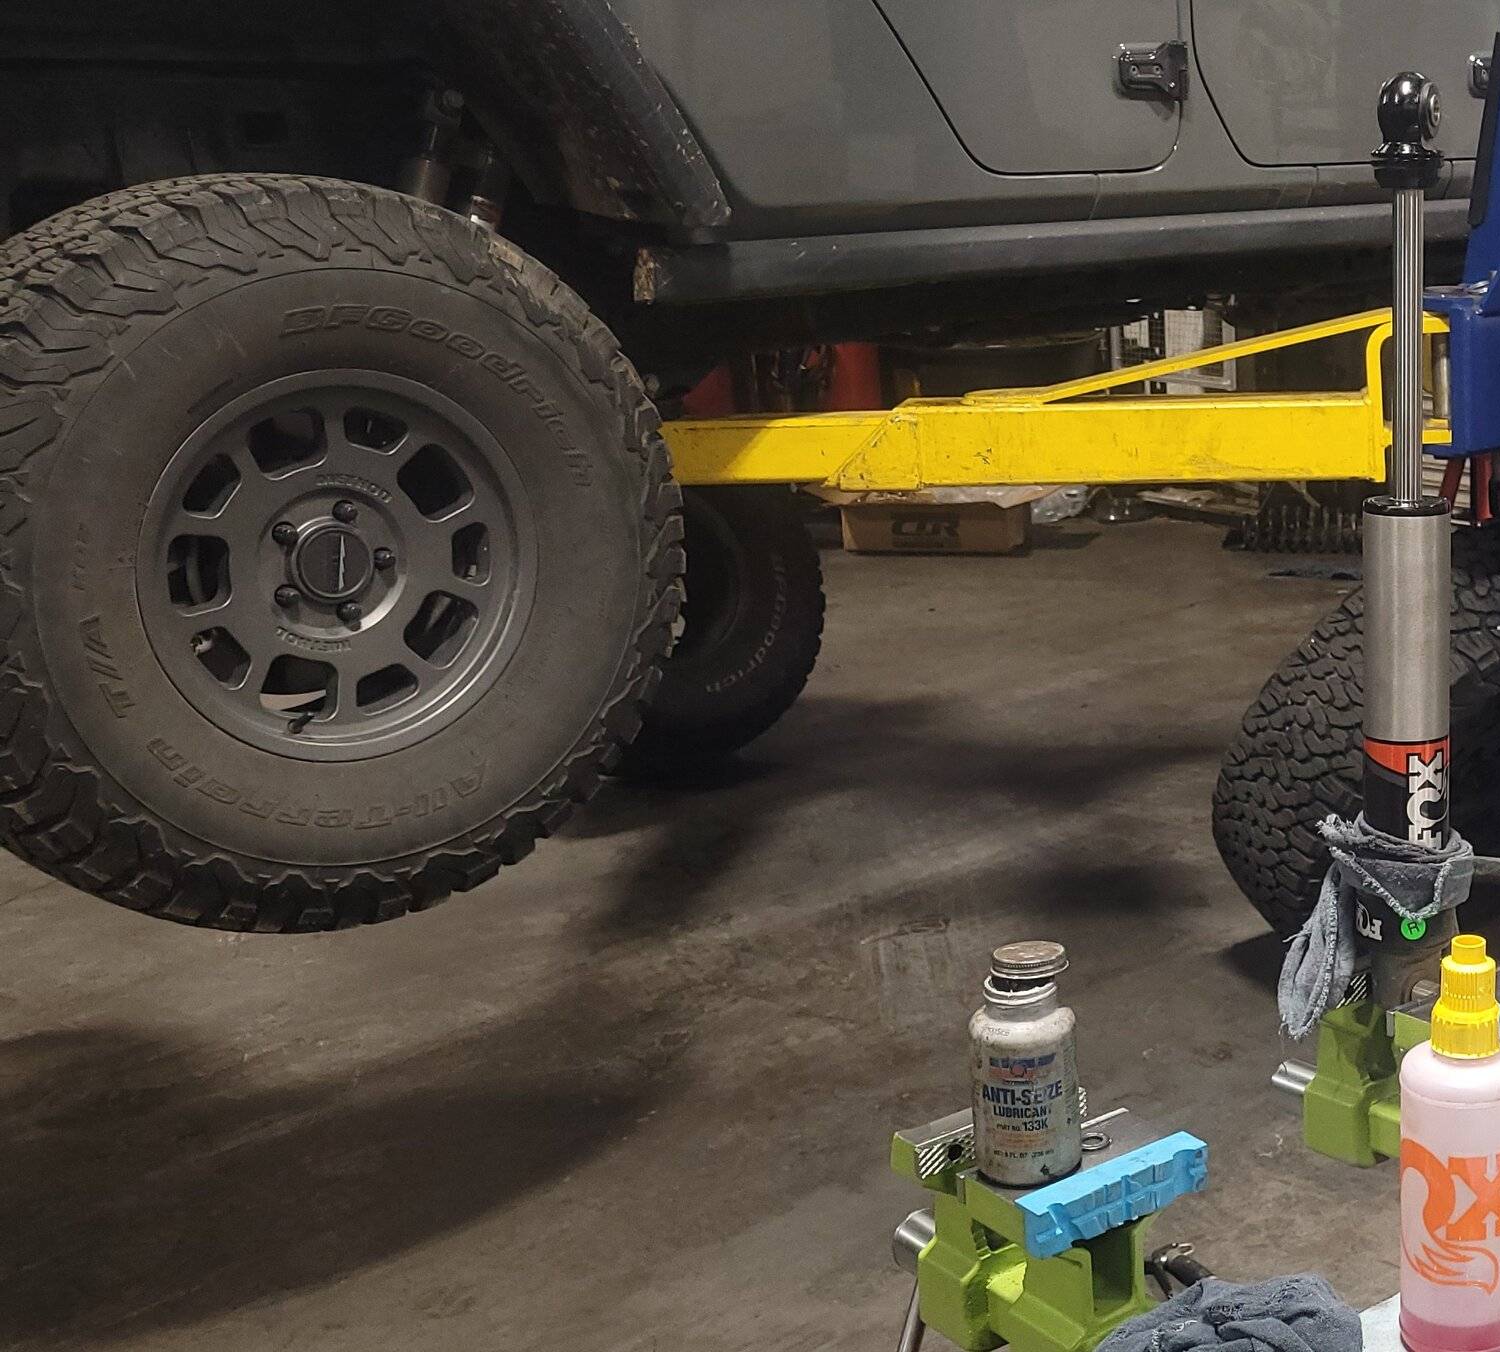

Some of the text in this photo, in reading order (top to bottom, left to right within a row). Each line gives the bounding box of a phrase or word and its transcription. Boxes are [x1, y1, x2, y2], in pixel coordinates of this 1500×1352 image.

[1407, 920, 1420, 935] R
[982, 1080, 1063, 1105] ANTI-SEIZE
[1023, 1119, 1049, 1132] 133K
